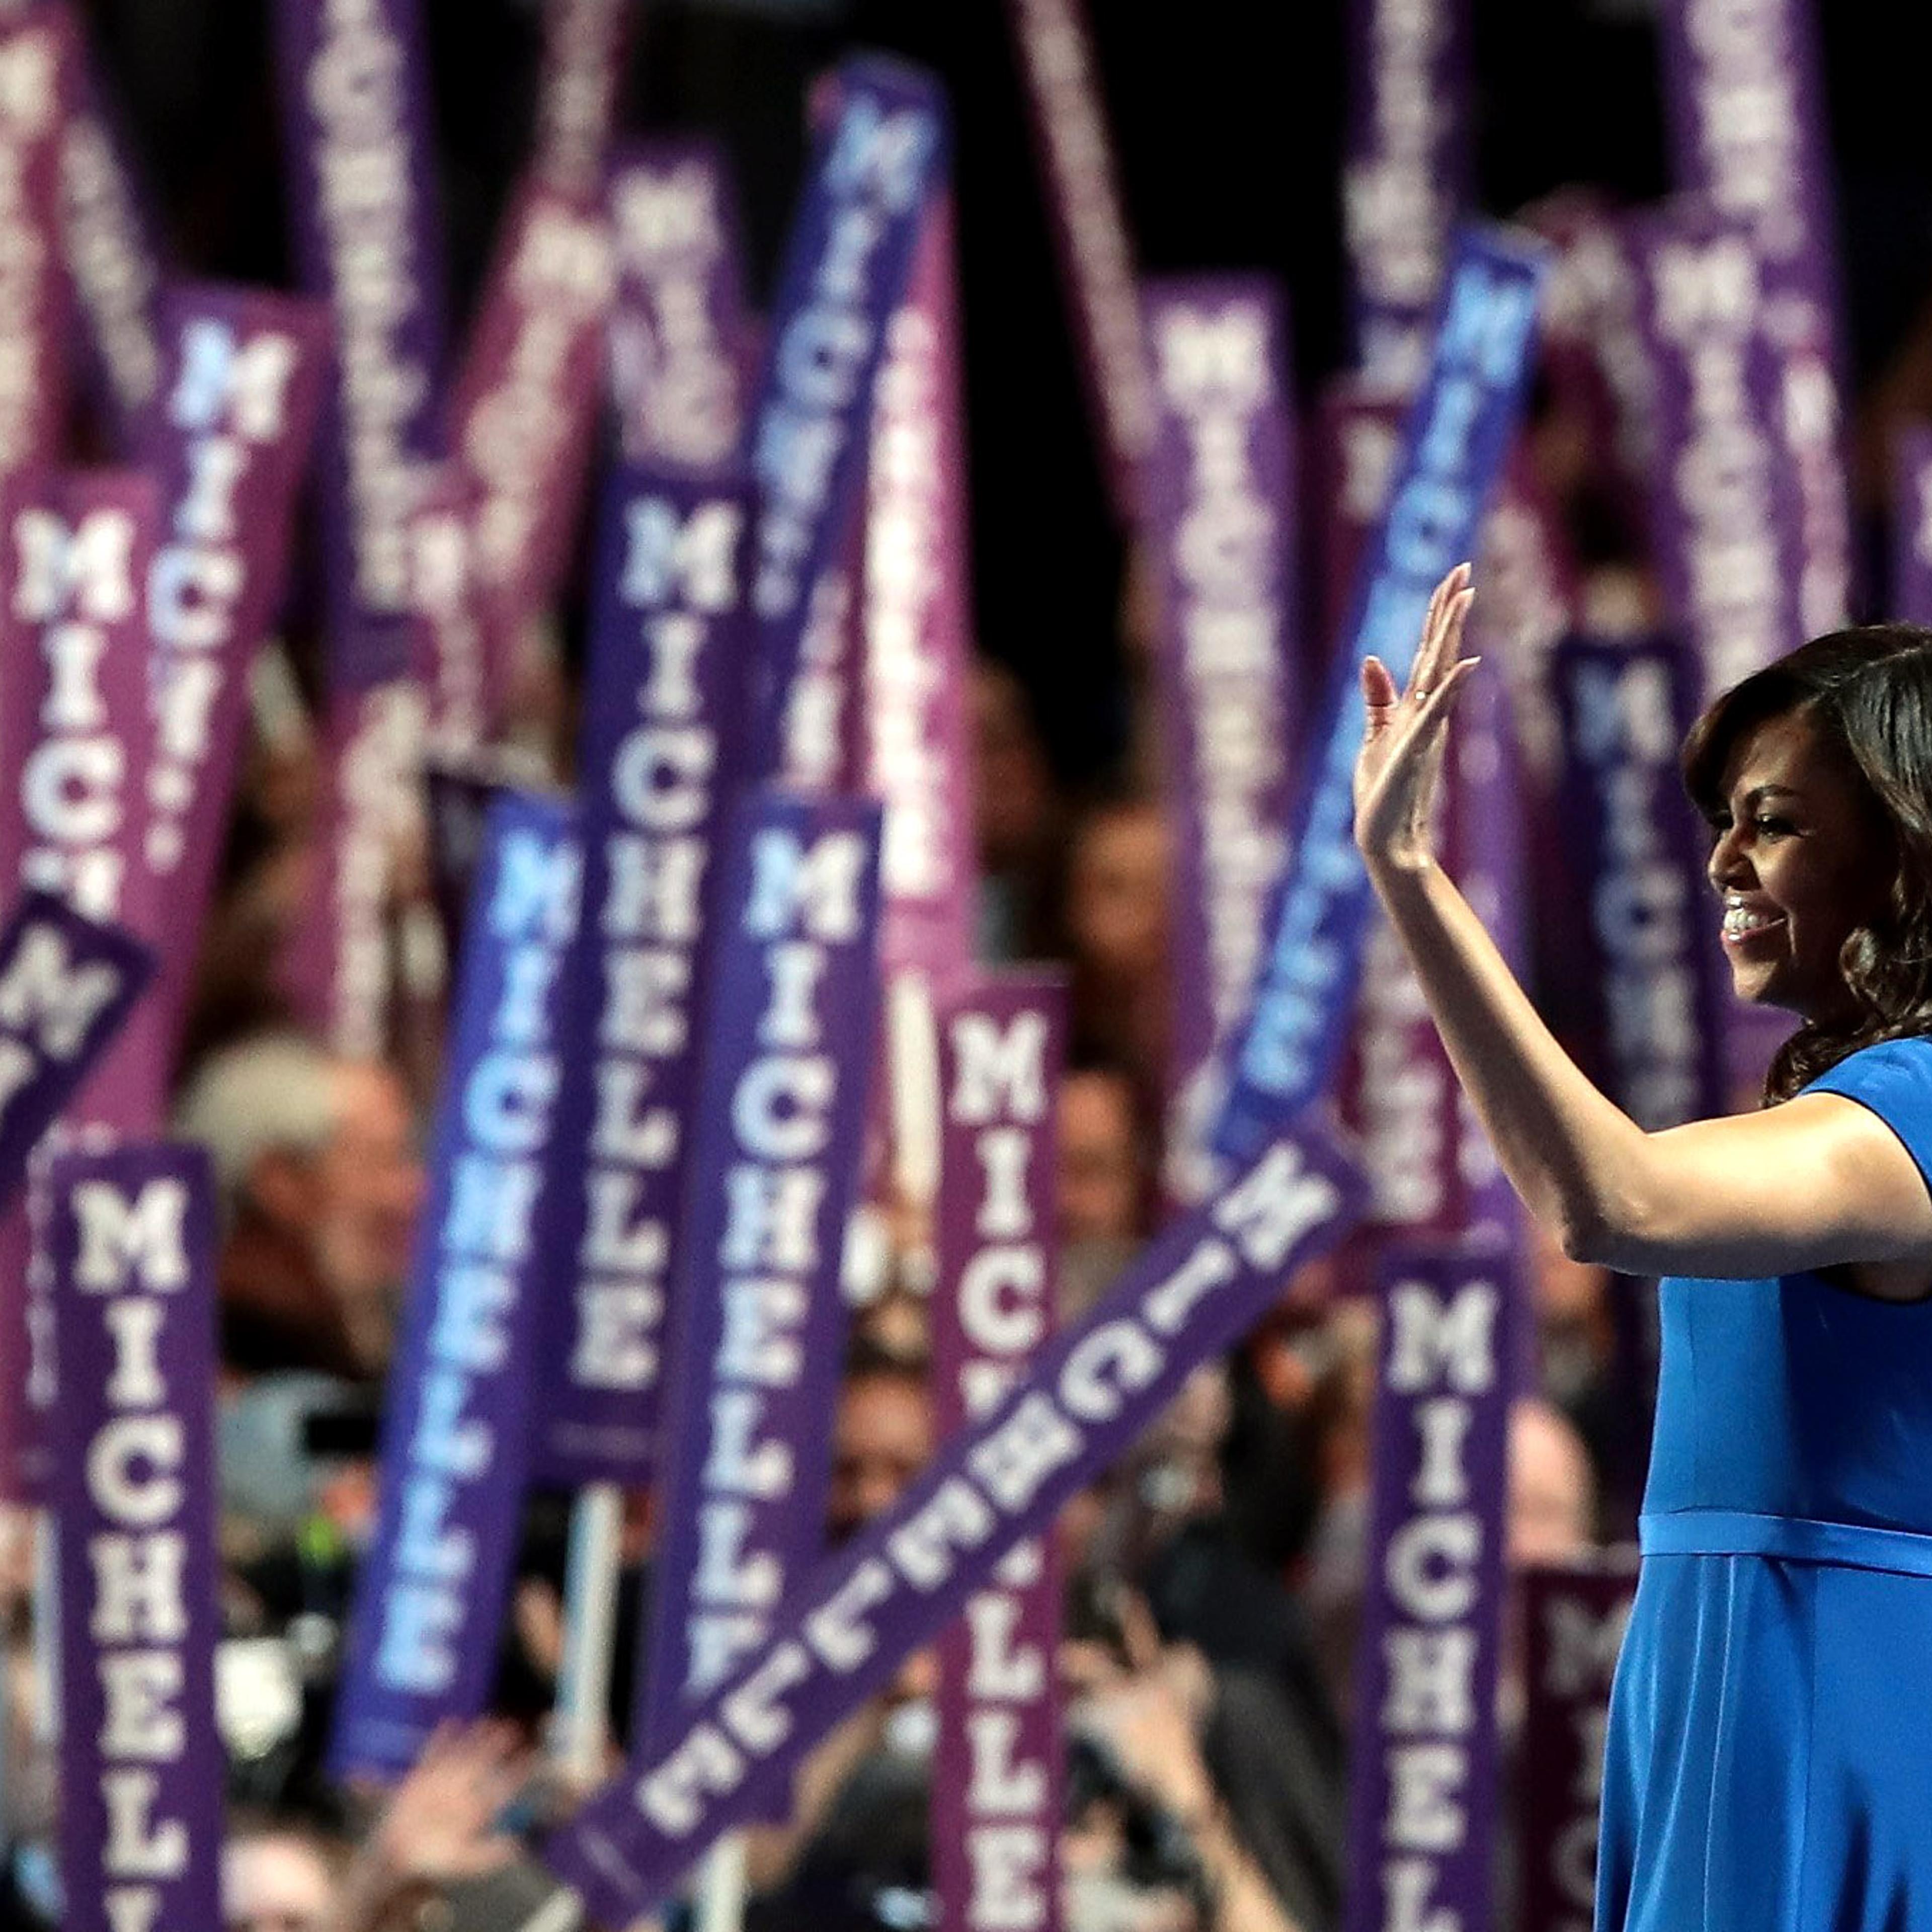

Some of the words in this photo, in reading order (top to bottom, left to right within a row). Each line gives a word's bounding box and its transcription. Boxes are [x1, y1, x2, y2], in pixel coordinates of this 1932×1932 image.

[568, 493, 745, 1393] MICHELLE
[1244, 259, 1542, 1091] MICHLLE
[375, 825, 588, 1696] MICHELLE
[635, 1138, 1342, 1839] MICHELLE
[945, 1009, 1051, 1931] MICLLE
